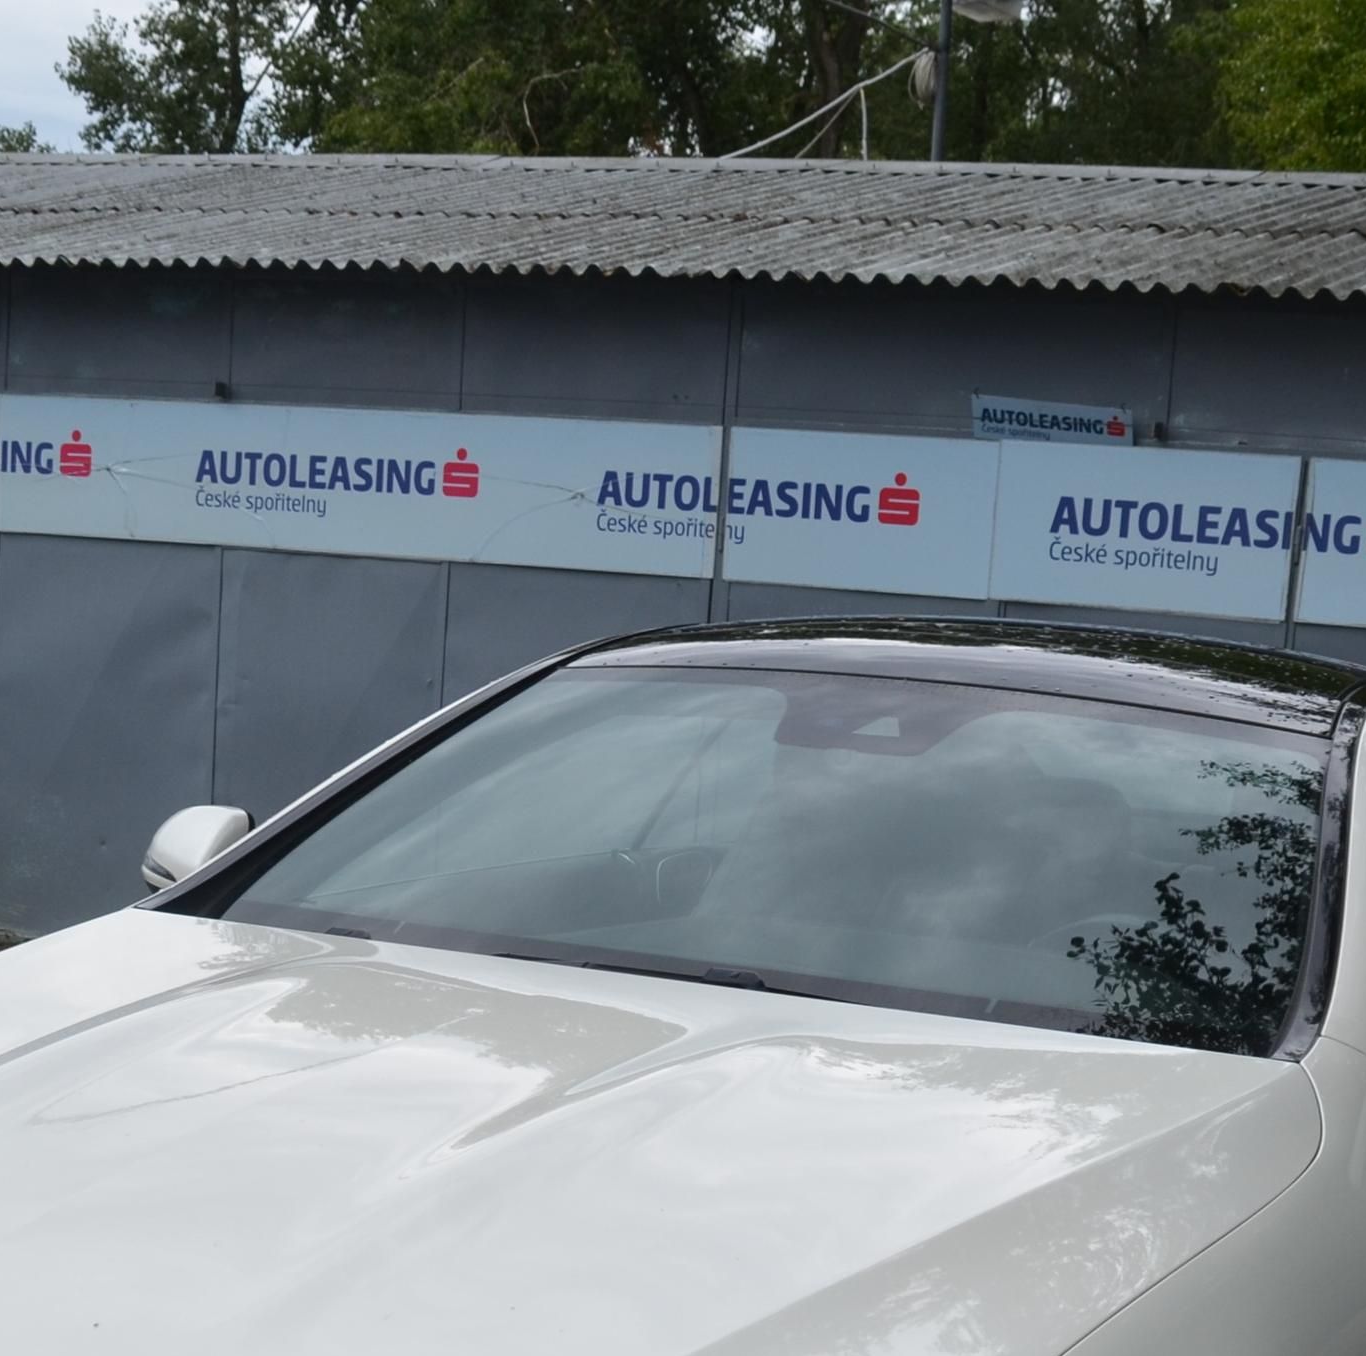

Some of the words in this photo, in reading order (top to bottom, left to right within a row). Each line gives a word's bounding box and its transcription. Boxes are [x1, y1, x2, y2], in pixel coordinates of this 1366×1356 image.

[981, 407, 1104, 435] AUTOLEASING
[195, 449, 435, 496] AUTOLEASING
[195, 485, 241, 509] České
[245, 492, 327, 518] spořitelny
[596, 469, 871, 523] AUTOLEASING
[596, 509, 648, 535] České
[653, 517, 745, 545] spořiteny
[1049, 495, 1362, 555] AUTOLEASING
[1049, 535, 1108, 564] České
[1112, 546, 1219, 577] spořitelny
